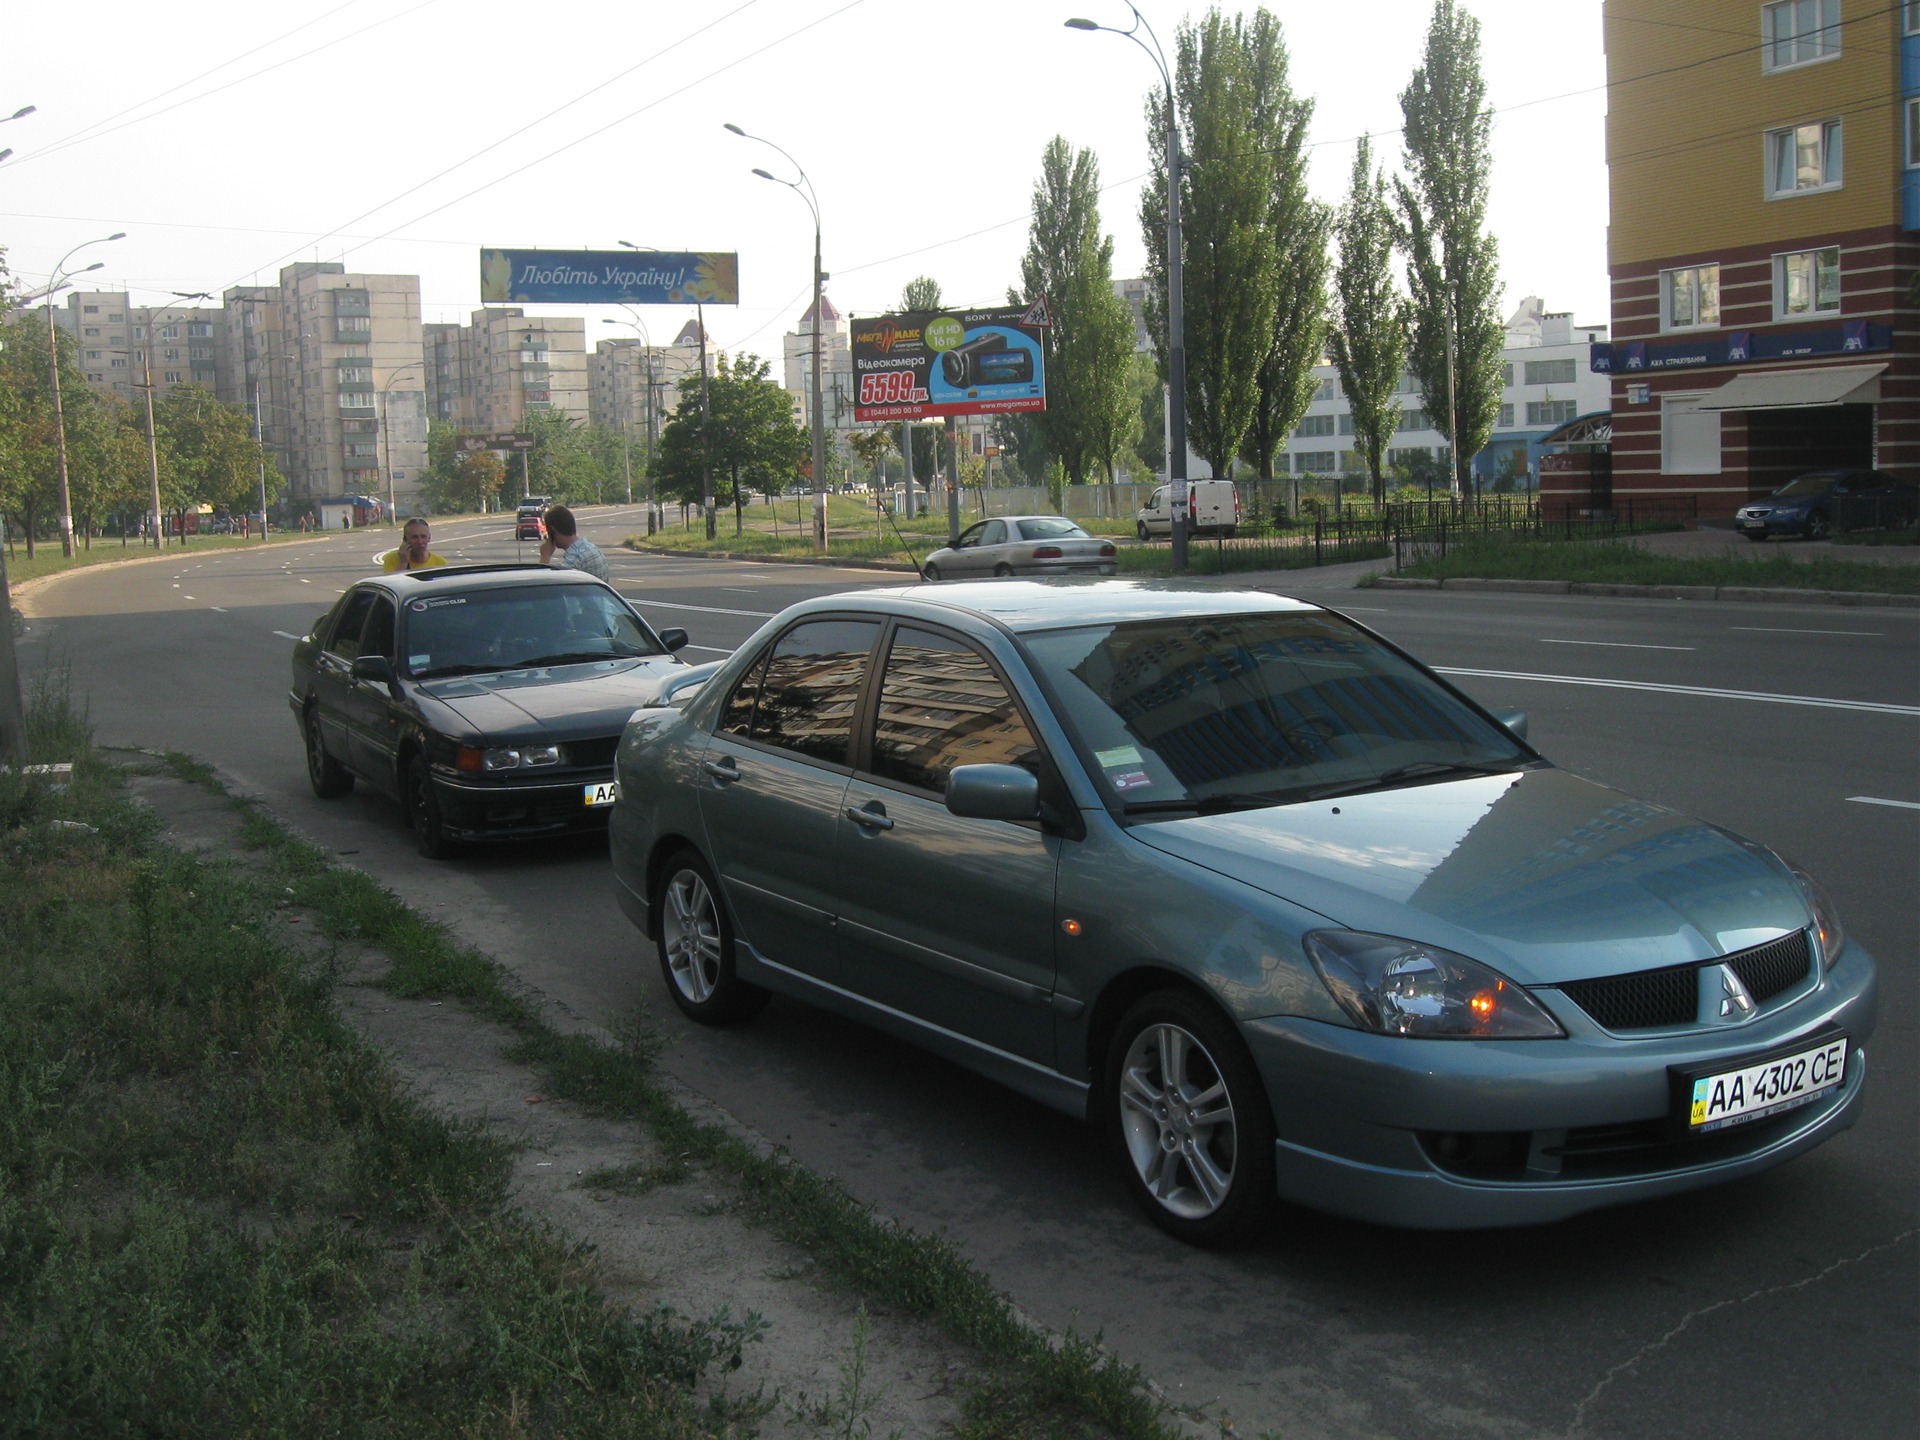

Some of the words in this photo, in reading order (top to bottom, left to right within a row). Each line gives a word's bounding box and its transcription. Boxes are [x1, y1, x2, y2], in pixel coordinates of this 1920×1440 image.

[519, 265, 598, 285] Любіть
[601, 266, 684, 291] Україну!
[965, 314, 992, 322] SONY
[929, 325, 944, 336] Full
[946, 324, 960, 334] HD
[934, 336, 945, 346] 16
[1842, 337, 1862, 350] AXA
[1728, 347, 1746, 360] AXA
[857, 357, 926, 369] Відеокамера
[1593, 358, 1610, 369] AXA
[1626, 357, 1642, 368] AXA
[1665, 356, 1707, 366] СТРАХУВАННЯ
[860, 371, 915, 405] 5599
[871, 408, 888, 416] (044)
[889, 407, 902, 415] 200
[1708, 1076, 1745, 1115] AA
[1753, 1058, 1806, 1102] 4302
[1811, 1045, 1841, 1084] CE
[1692, 1107, 1704, 1119] UA
